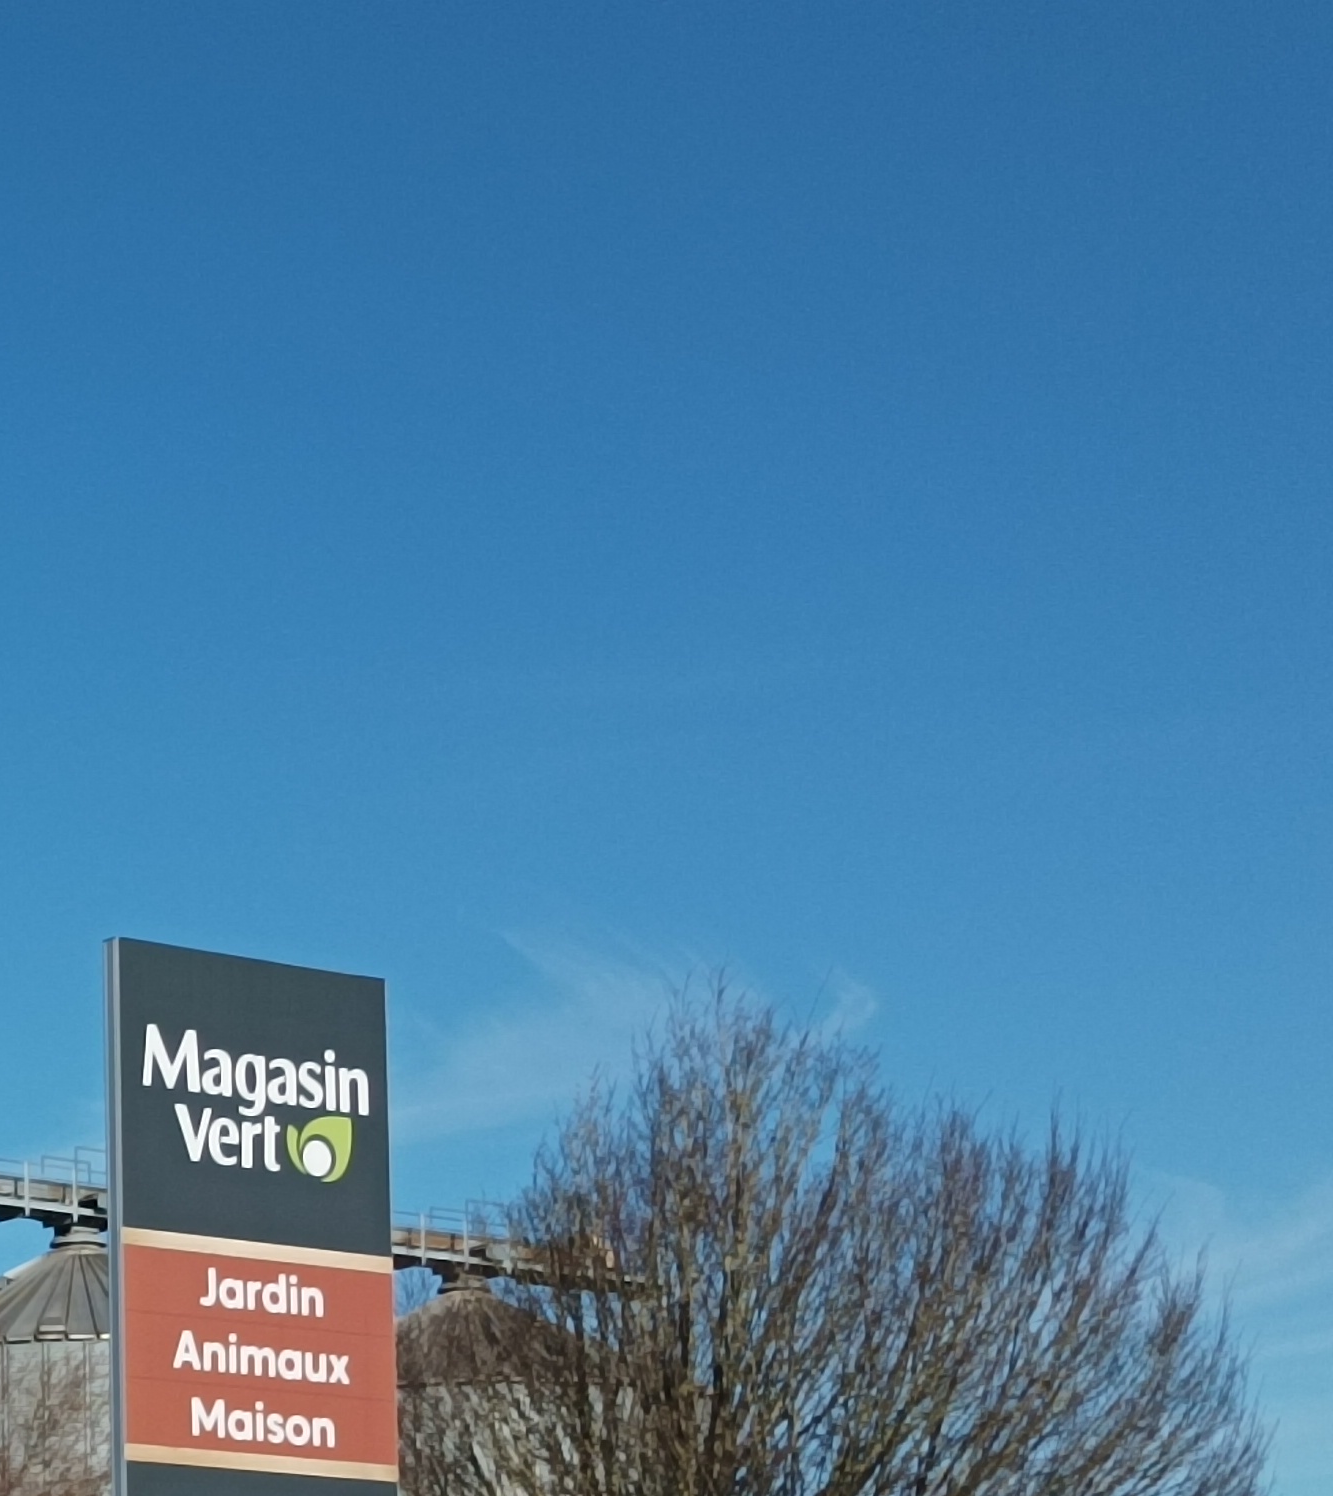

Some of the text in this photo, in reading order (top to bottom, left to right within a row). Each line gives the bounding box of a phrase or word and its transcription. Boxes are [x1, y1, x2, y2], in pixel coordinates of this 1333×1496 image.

[142, 1023, 370, 1117] Magasin
[174, 1103, 281, 1172] Vert
[199, 1267, 325, 1318] Jardin
[173, 1330, 350, 1385] Animaux
[190, 1397, 336, 1448] Maison
